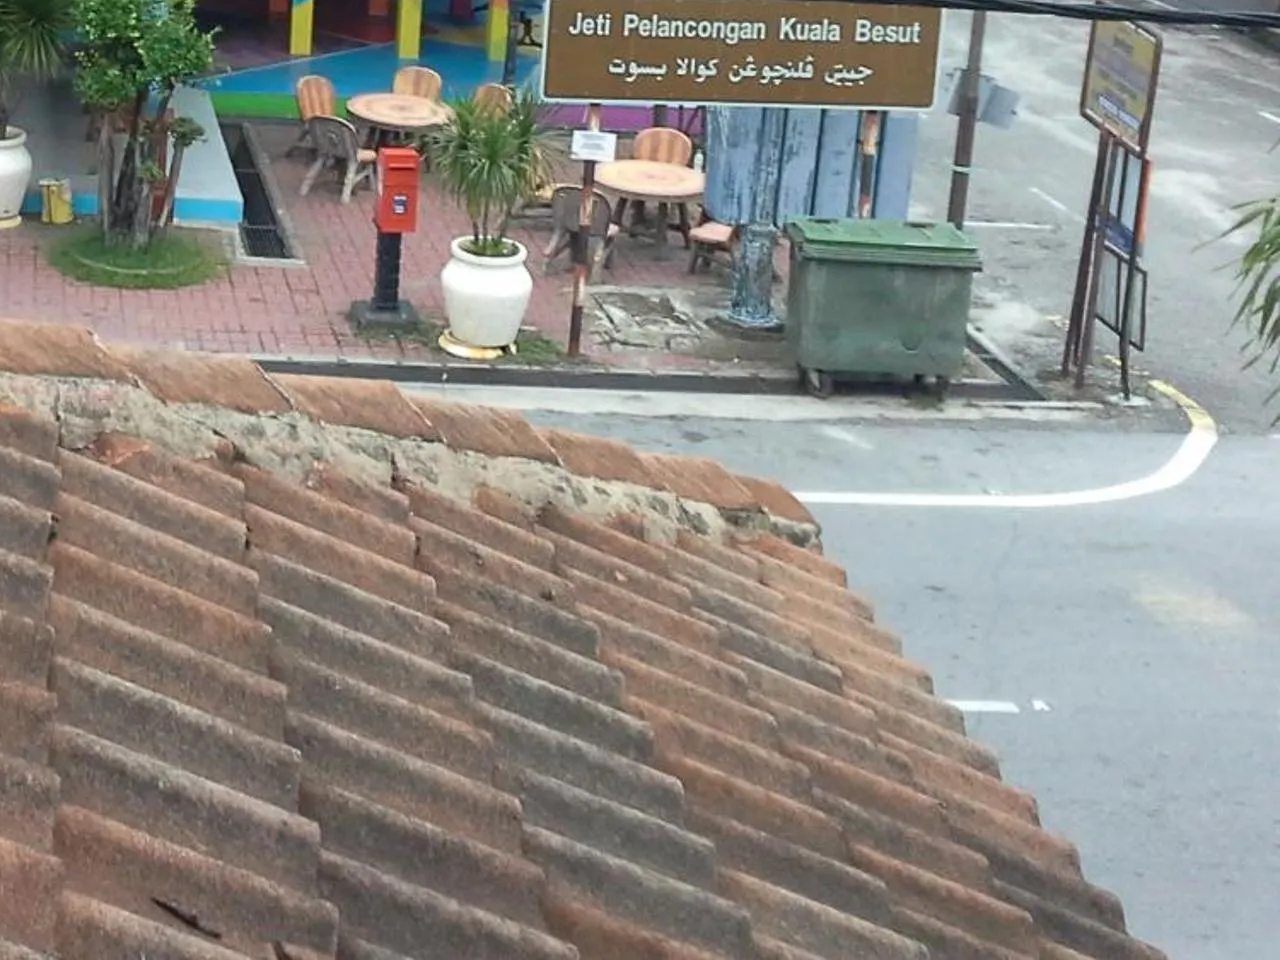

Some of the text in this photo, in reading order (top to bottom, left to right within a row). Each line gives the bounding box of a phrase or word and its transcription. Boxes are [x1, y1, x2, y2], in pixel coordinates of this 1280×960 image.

[569, 13, 921, 45] Jeti Pelancongan Kuala Besut
